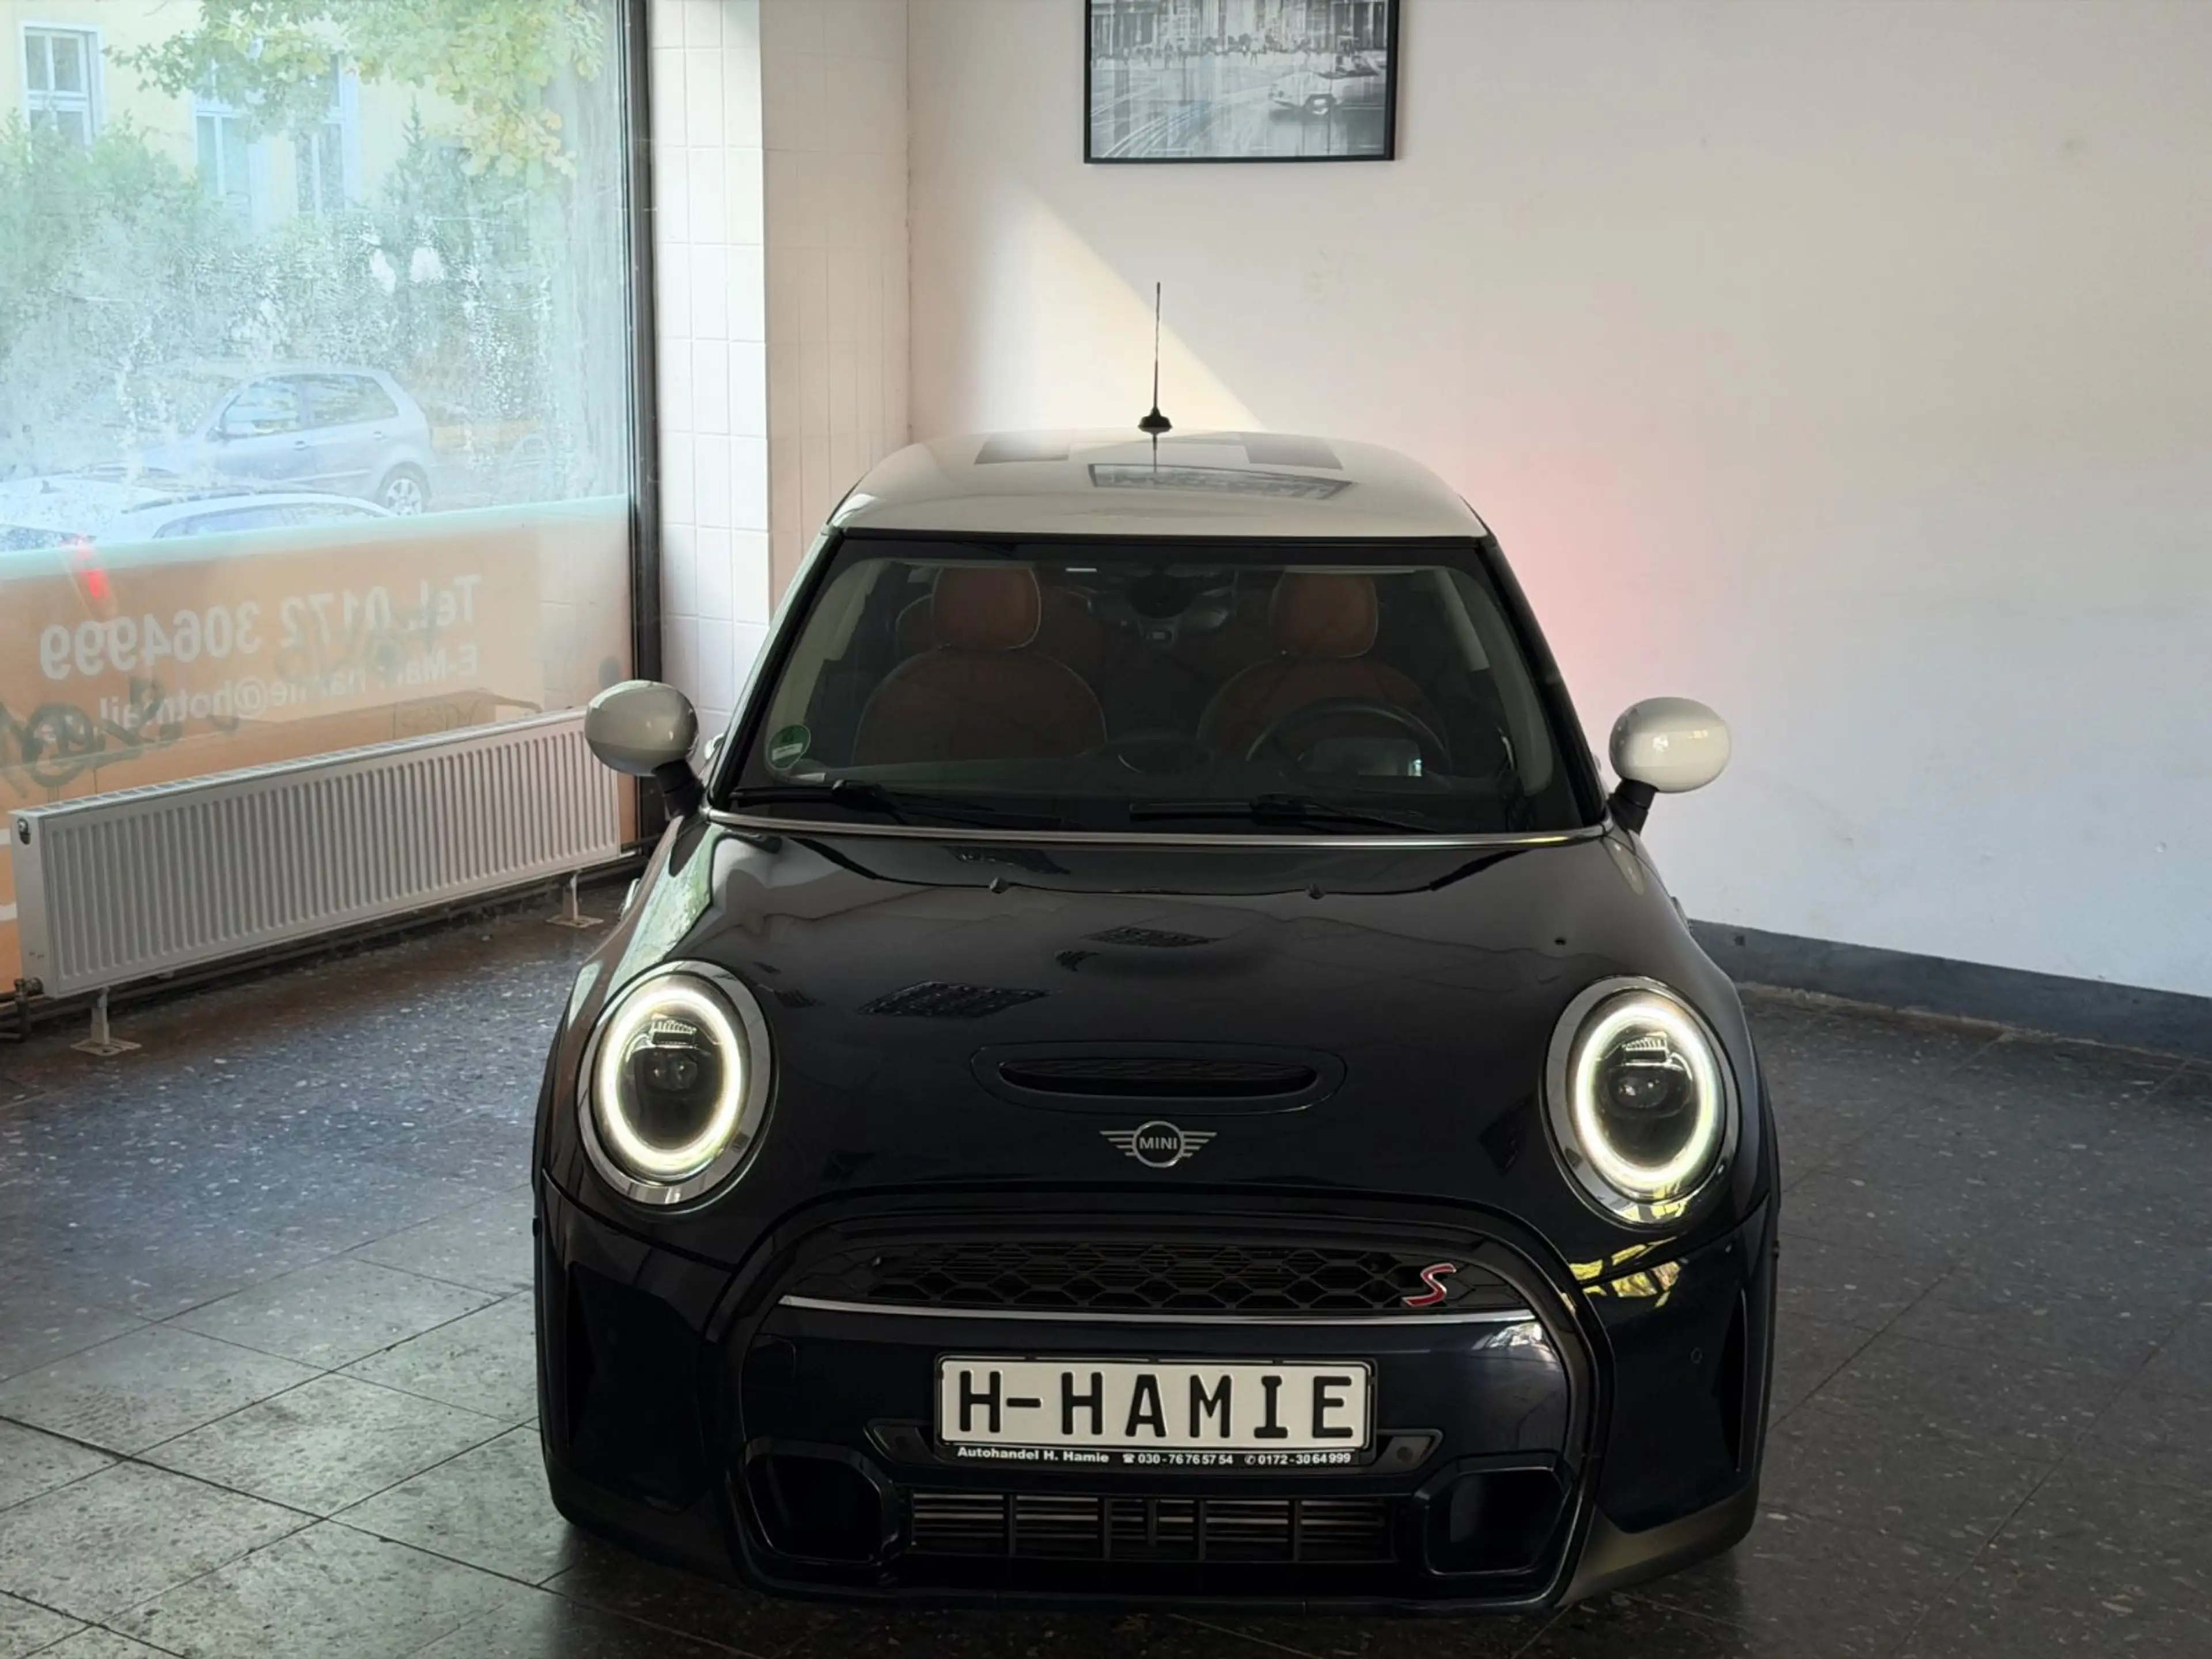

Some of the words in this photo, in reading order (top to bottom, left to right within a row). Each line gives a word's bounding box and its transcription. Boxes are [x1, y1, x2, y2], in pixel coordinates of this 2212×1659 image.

[1139, 1137, 1178, 1150] MINI
[1402, 1262, 1457, 1307] S
[957, 1446, 1039, 1459] Autohandel
[1044, 1450, 1058, 1460] H.
[1063, 1452, 1109, 1463] Hamie
